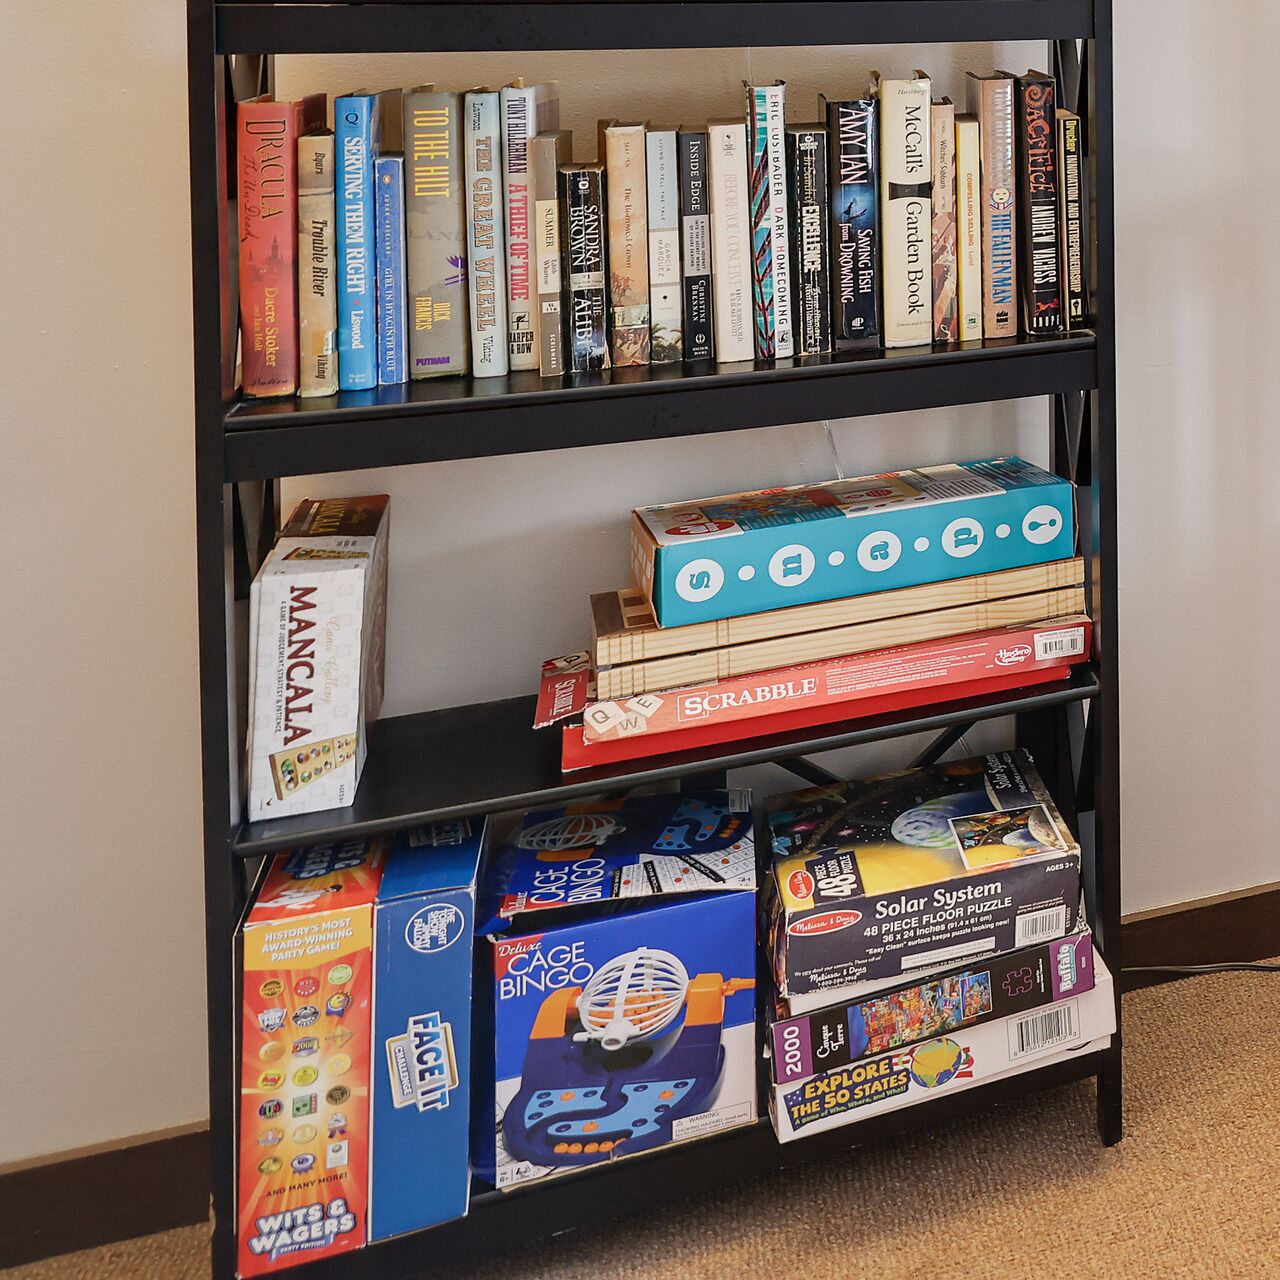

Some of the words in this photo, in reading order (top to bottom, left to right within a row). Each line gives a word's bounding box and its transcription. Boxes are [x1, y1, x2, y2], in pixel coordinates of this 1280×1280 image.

[414, 107, 450, 127] TO
[506, 96, 527, 114] TONY
[414, 130, 450, 160] THE
[507, 115, 529, 174] HILLERMAN
[839, 107, 868, 152] AMY
[905, 106, 922, 174] McCall's
[1024, 84, 1055, 196] SACRIFICE
[1065, 120, 1078, 153] Drucker
[246, 119, 287, 220] DRACULA
[344, 137, 363, 199] SERVING
[474, 136, 492, 173] THE
[690, 141, 700, 177] INSIDE
[840, 153, 867, 186] TAN
[414, 165, 450, 197] HILT
[509, 183, 528, 195] A
[691, 179, 702, 211] EDGE
[1066, 154, 1079, 201] INNOVATION
[346, 201, 364, 246] THEM
[472, 177, 494, 250] GREAT
[509, 195, 529, 241] THIEF
[545, 207, 554, 249] SUMMER
[775, 207, 785, 240] DARK
[991, 211, 1012, 228] THE
[1031, 205, 1056, 244] ANDREW
[1068, 202, 1080, 219] AND
[510, 242, 529, 259] OF
[570, 206, 587, 268] BROWN
[584, 204, 600, 266] SANDRA
[857, 229, 873, 267] SAVING
[905, 200, 924, 265] Garden
[991, 228, 1012, 272] FALLEN
[345, 248, 365, 296] RIGHT
[1033, 248, 1057, 288] VACHSS
[1069, 219, 1082, 294] ENTREPRENEURSHIP
[474, 255, 496, 332] WHEEL
[511, 260, 530, 302] TIME
[776, 245, 789, 327] HOMECOMING
[858, 270, 873, 294] FISH
[908, 269, 925, 315] Book
[992, 273, 1013, 306] MAN
[415, 297, 433, 331] FRANCIS
[433, 301, 450, 322] DICK
[592, 295, 601, 317] THE
[692, 284, 700, 323] BRENNAN
[698, 280, 707, 324] CHRISTINE
[350, 310, 364, 350] Liswood
[574, 298, 593, 347] ALIBI
[415, 355, 450, 367] PUTNAM
[283, 585, 318, 746] MANCALA
[999, 646, 1033, 658] Hasbro
[552, 678, 577, 717] SCRABBLE
[637, 698, 652, 709] E
[684, 677, 817, 717] SCRABBLE
[591, 710, 610, 725] Q
[619, 716, 639, 731] W
[829, 857, 840, 879] FLOOR
[839, 853, 851, 876] PUZZLE
[1045, 863, 1065, 874] AGES
[1064, 861, 1074, 870] 3+
[819, 873, 858, 898] 48
[874, 895, 928, 920] Solar
[932, 881, 1002, 910] System
[265, 923, 320, 943] HISTORY'S
[321, 918, 352, 931] MOST
[795, 920, 828, 934] Melissa
[829, 917, 835, 925] &
[835, 915, 856, 926] Doug
[863, 925, 879, 937] 48
[881, 916, 919, 934] PIECE
[922, 906, 964, 925] FLOOR
[967, 896, 1013, 916] PUZZLE
[262, 928, 354, 954] AWARD-WINNING
[271, 949, 306, 964] PARTY
[307, 941, 341, 955] GAME!
[498, 941, 543, 957] Deluxe
[865, 946, 884, 956] "Easy
[907, 936, 932, 948] surface
[931, 932, 951, 943] keeps
[951, 927, 972, 939] puzzle
[972, 921, 995, 935] looking
[995, 918, 1011, 928] new!
[507, 941, 585, 975] CAGE
[1057, 943, 1075, 994] Buffalo
[500, 962, 594, 1000] BINGO
[412, 1013, 446, 1085] FACE
[782, 1025, 802, 1077] 2000
[816, 1024, 835, 1059] Cinque
[829, 1023, 845, 1052] Terre
[393, 1045, 412, 1098] CHALLENGE
[804, 1058, 891, 1100] EXPLORE
[420, 1087, 448, 1111] IT
[791, 1100, 821, 1120] THE
[824, 1089, 850, 1109] 50
[853, 1070, 908, 1101] STATES
[265, 1188, 287, 1199] AND
[288, 1180, 317, 1193] MANY
[317, 1172, 348, 1185] MORE!
[250, 1213, 354, 1254] WAGERS
[257, 1203, 323, 1234] WITS
[329, 1198, 346, 1217] &
